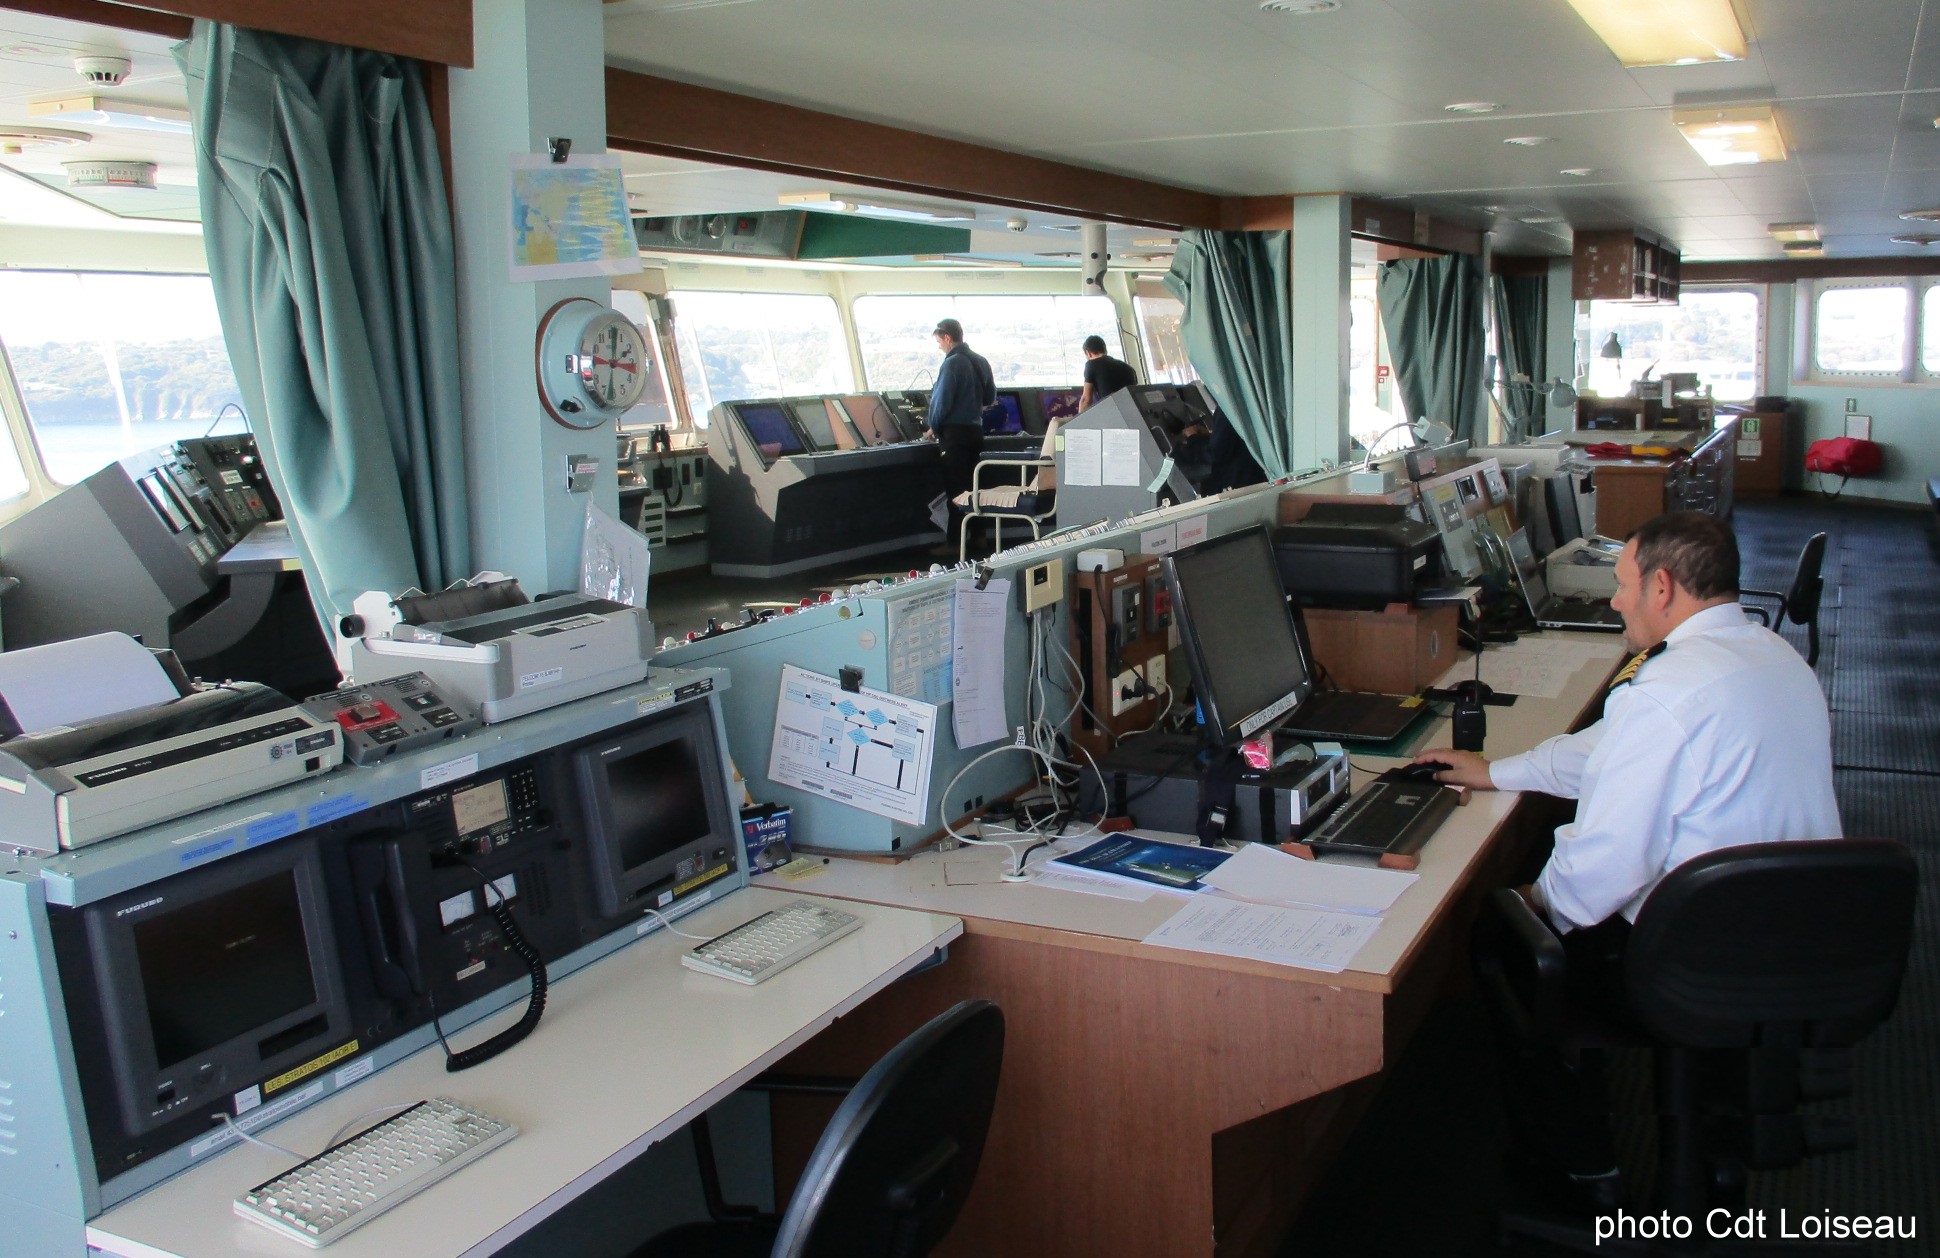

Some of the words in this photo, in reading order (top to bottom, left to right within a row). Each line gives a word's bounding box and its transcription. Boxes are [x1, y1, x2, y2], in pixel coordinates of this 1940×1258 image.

[598, 332, 605, 344] 11
[626, 343, 632, 353] 2
[626, 373, 632, 384] 4
[601, 384, 607, 396] 7
[620, 384, 626, 396] 5
[756, 818, 787, 832] Verbatim
[116, 896, 164, 917] FURUNO
[284, 1062, 319, 1083] STRATOS
